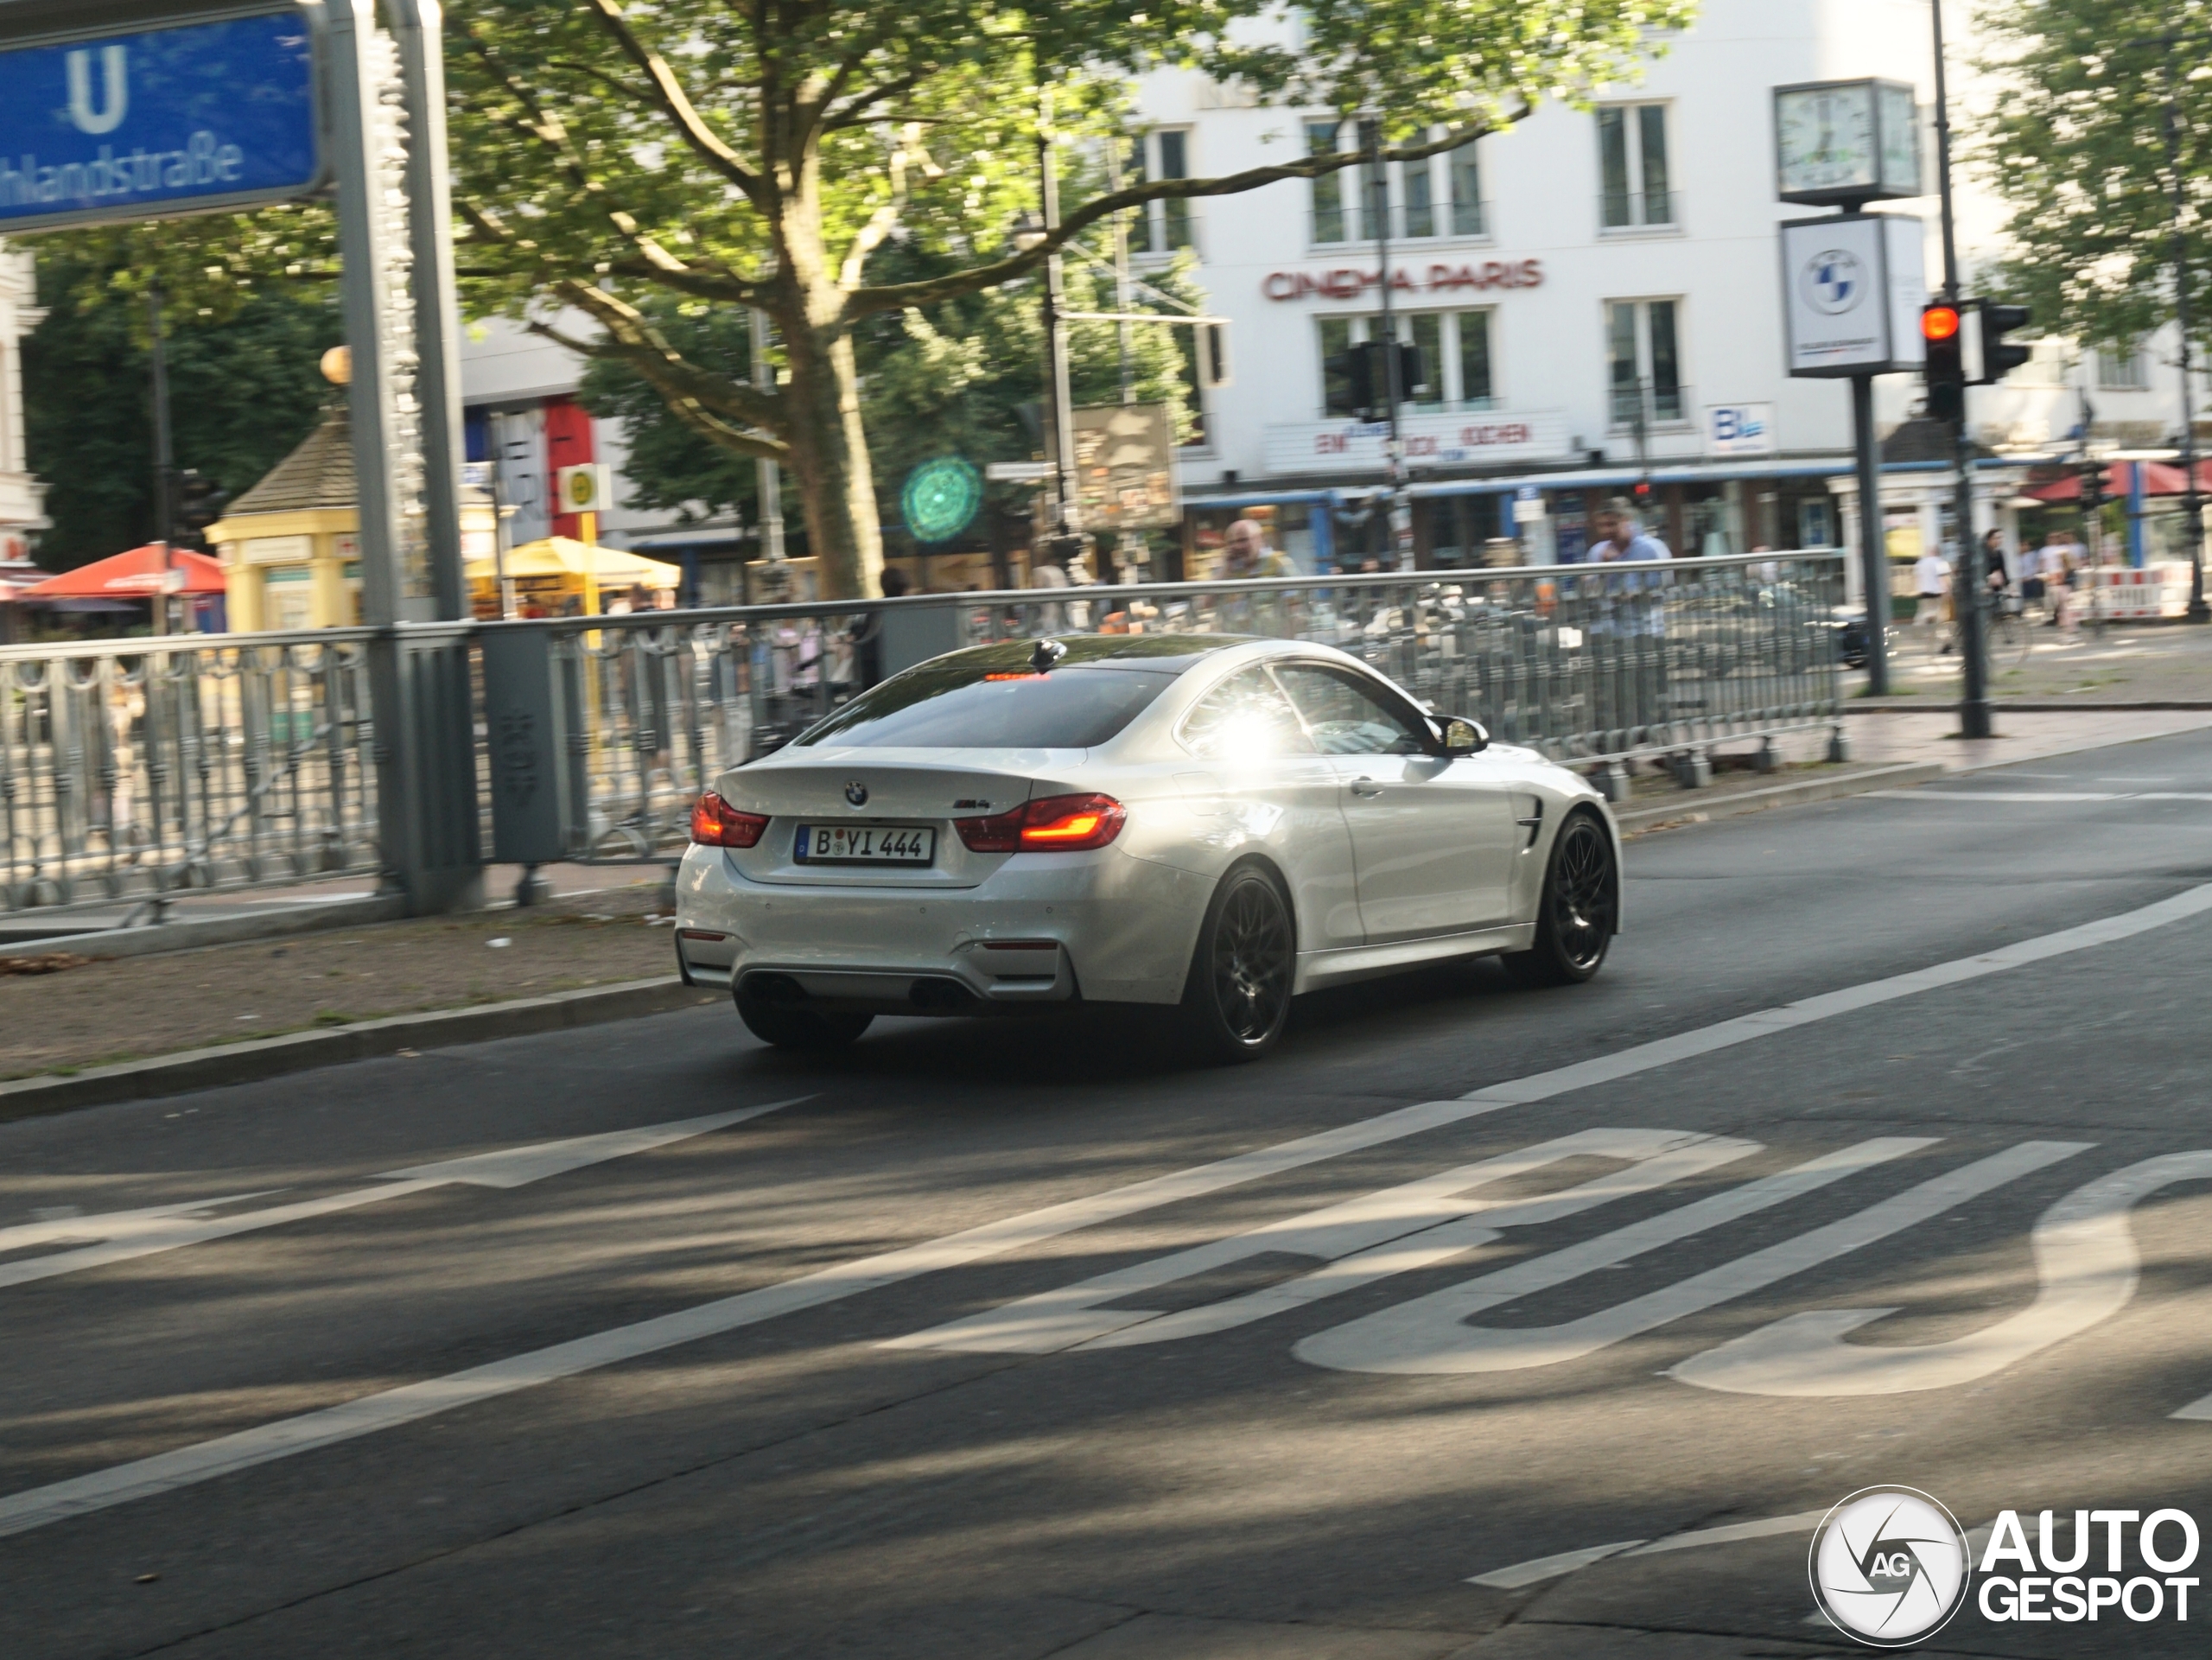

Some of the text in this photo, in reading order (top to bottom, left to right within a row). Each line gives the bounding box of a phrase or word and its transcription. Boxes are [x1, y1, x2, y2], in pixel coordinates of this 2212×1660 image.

[67, 45, 128, 134] U
[1262, 258, 1544, 302] CINEMA PARIS
[816, 830, 830, 855] B
[846, 830, 872, 855] YI
[880, 831, 922, 857] 444
[873, 1126, 2212, 1397] BUS
